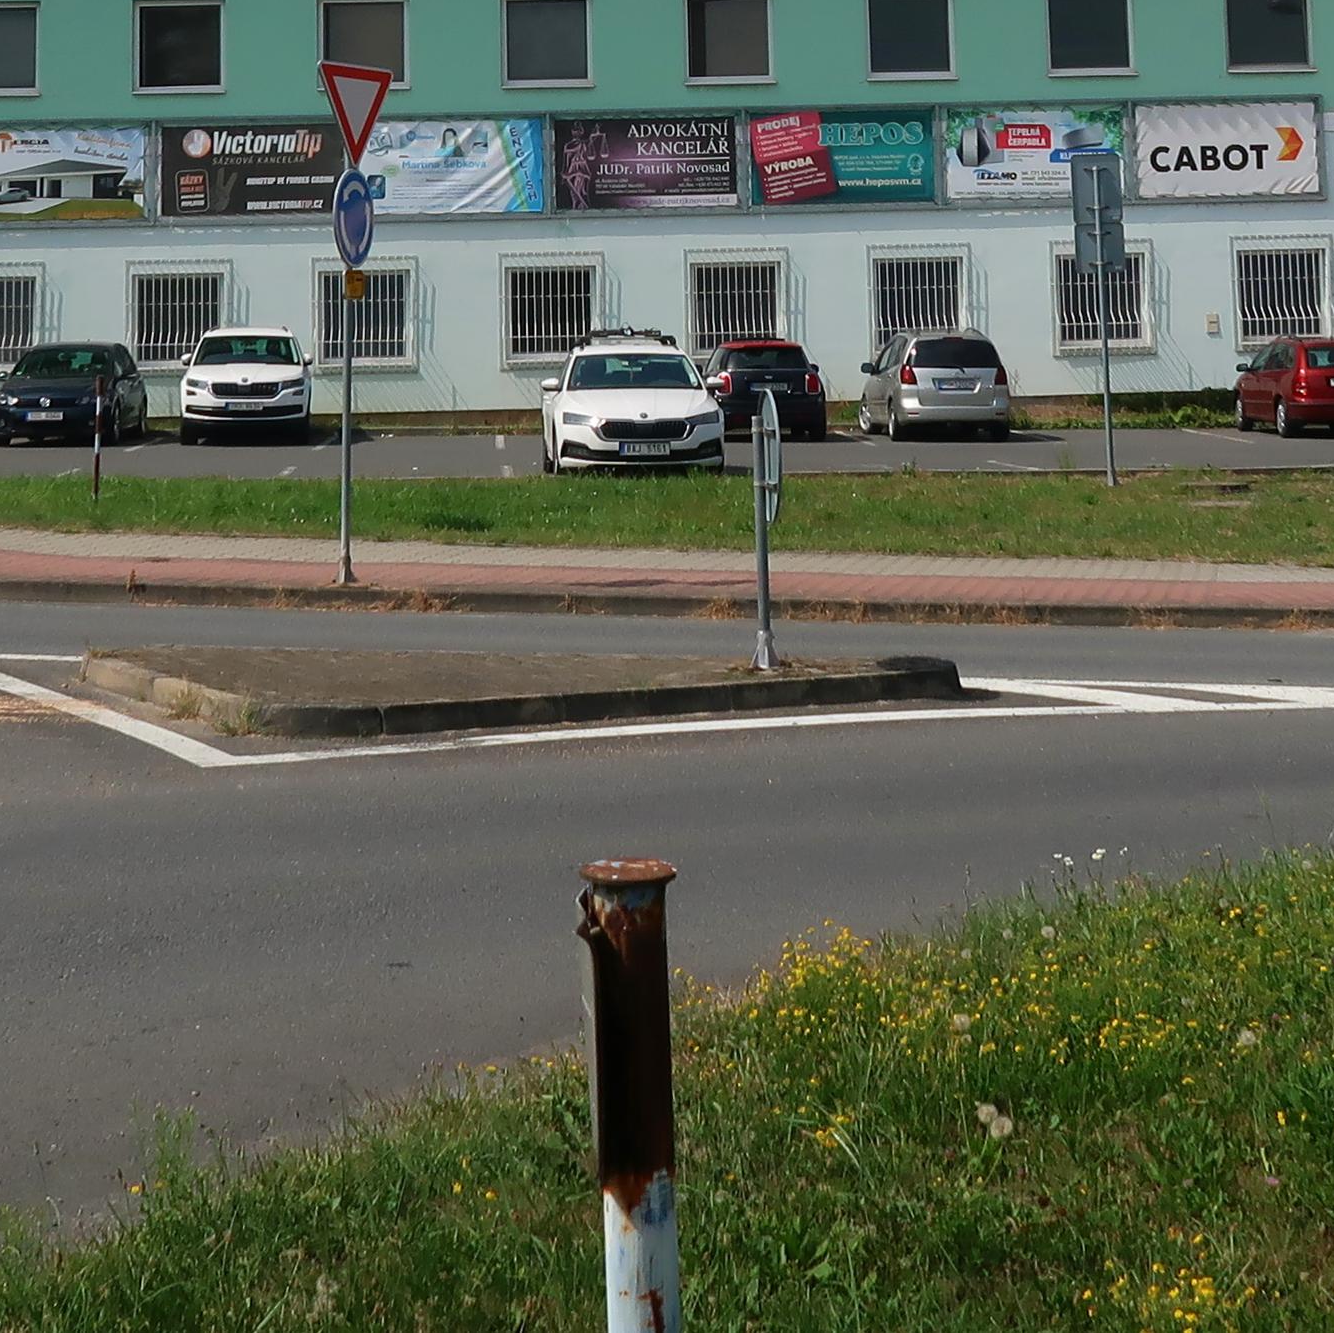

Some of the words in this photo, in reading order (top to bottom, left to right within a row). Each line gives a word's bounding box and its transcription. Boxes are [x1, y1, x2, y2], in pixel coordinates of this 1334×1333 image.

[627, 119, 728, 138] ADVOKÁTNÍ
[757, 116, 801, 133] PRODEJ
[818, 122, 924, 146] HEPOS
[212, 129, 322, 158] VictoriaTip
[637, 138, 730, 156] KANCELÁŘ
[509, 127, 537, 200] ENGLISH
[764, 155, 814, 174] VÝROBA
[1149, 144, 1269, 173] CABOT
[596, 164, 633, 176] JUDr.
[636, 163, 673, 174] Patrik
[677, 161, 730, 173] Novosad
[838, 177, 923, 188] www.heposvm.cz
